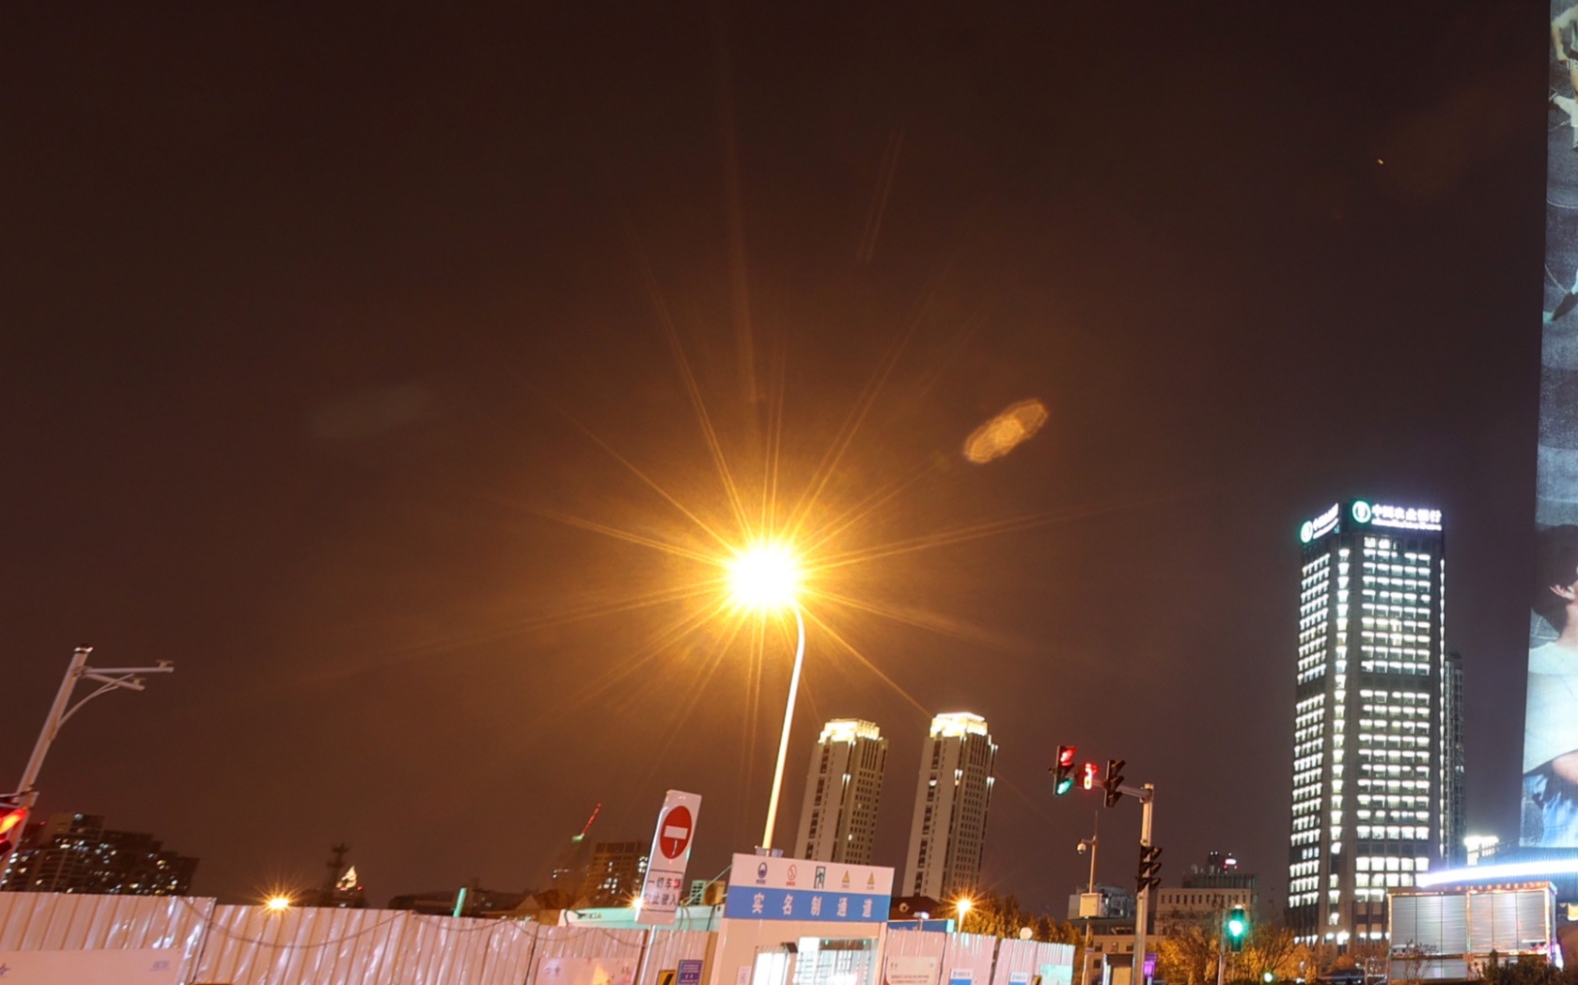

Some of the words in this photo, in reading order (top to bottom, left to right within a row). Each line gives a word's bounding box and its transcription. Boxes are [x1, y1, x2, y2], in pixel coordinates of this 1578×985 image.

[751, 892, 873, 918] 实名制通道
